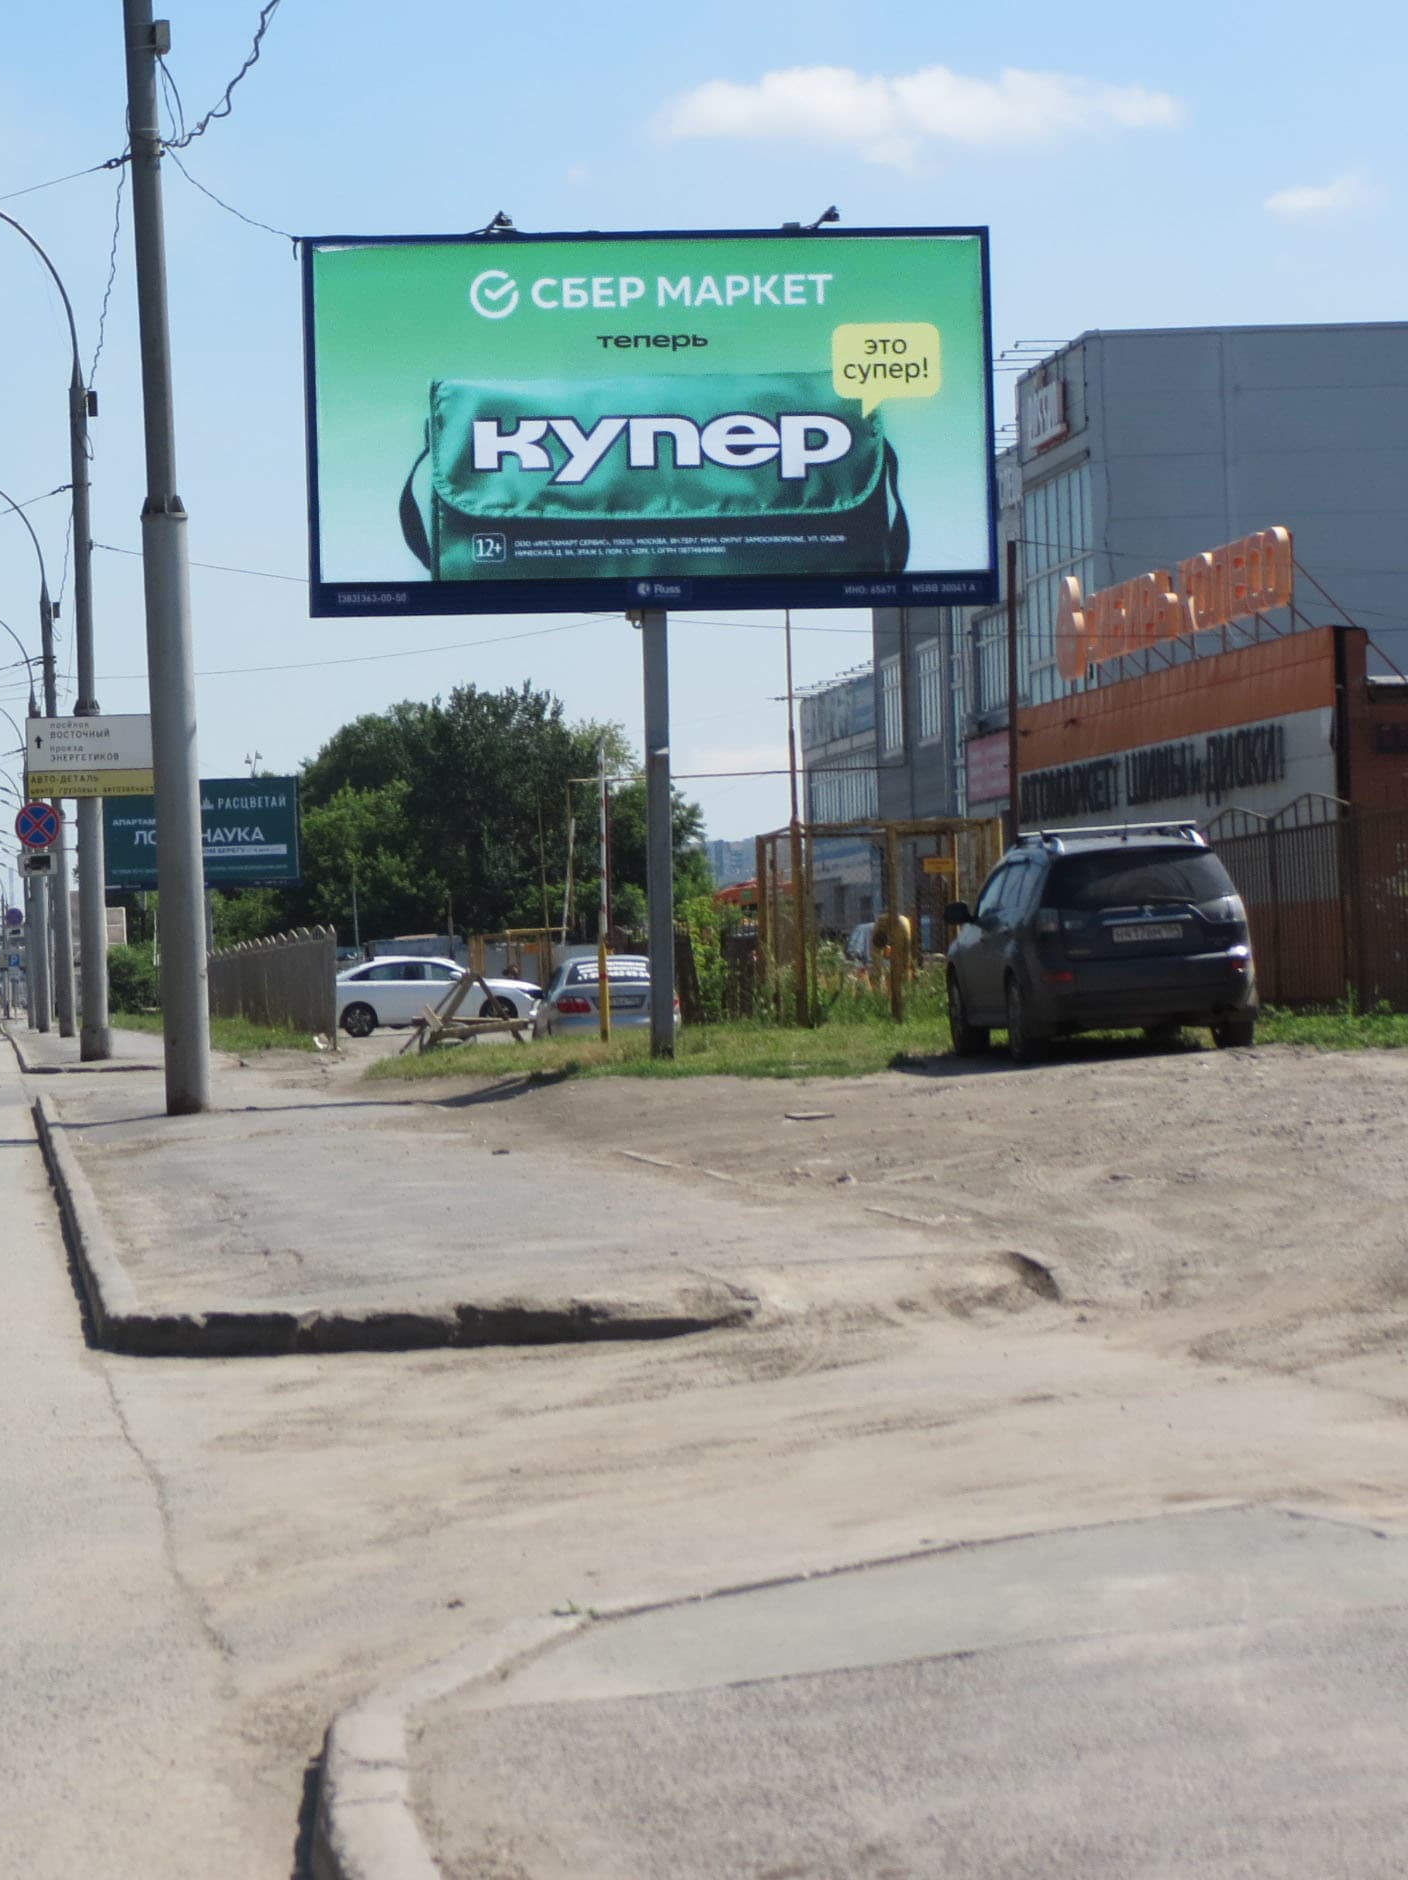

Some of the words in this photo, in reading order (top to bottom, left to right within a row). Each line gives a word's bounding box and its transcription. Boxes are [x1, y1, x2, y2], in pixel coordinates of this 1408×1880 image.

[531, 276, 645, 309] СБЕР
[657, 273, 833, 307] МАРКЕТ
[596, 333, 709, 351] теперь
[863, 338, 908, 355] это
[843, 357, 929, 385] супер!
[471, 411, 854, 485] купер
[475, 538, 503, 557] 12+
[654, 583, 682, 594] Russ
[49, 728, 111, 739] ВОСТОЧНЫЙ
[49, 752, 120, 762] ЭНЕРГЕТИКОВ
[30, 775, 99, 785] АВТО-ДЕТАЛЬ
[103, 785, 154, 794] автозапчаст
[217, 795, 287, 810] РАСЦВЕТАЙ
[112, 818, 157, 827] АПАРТАМ
